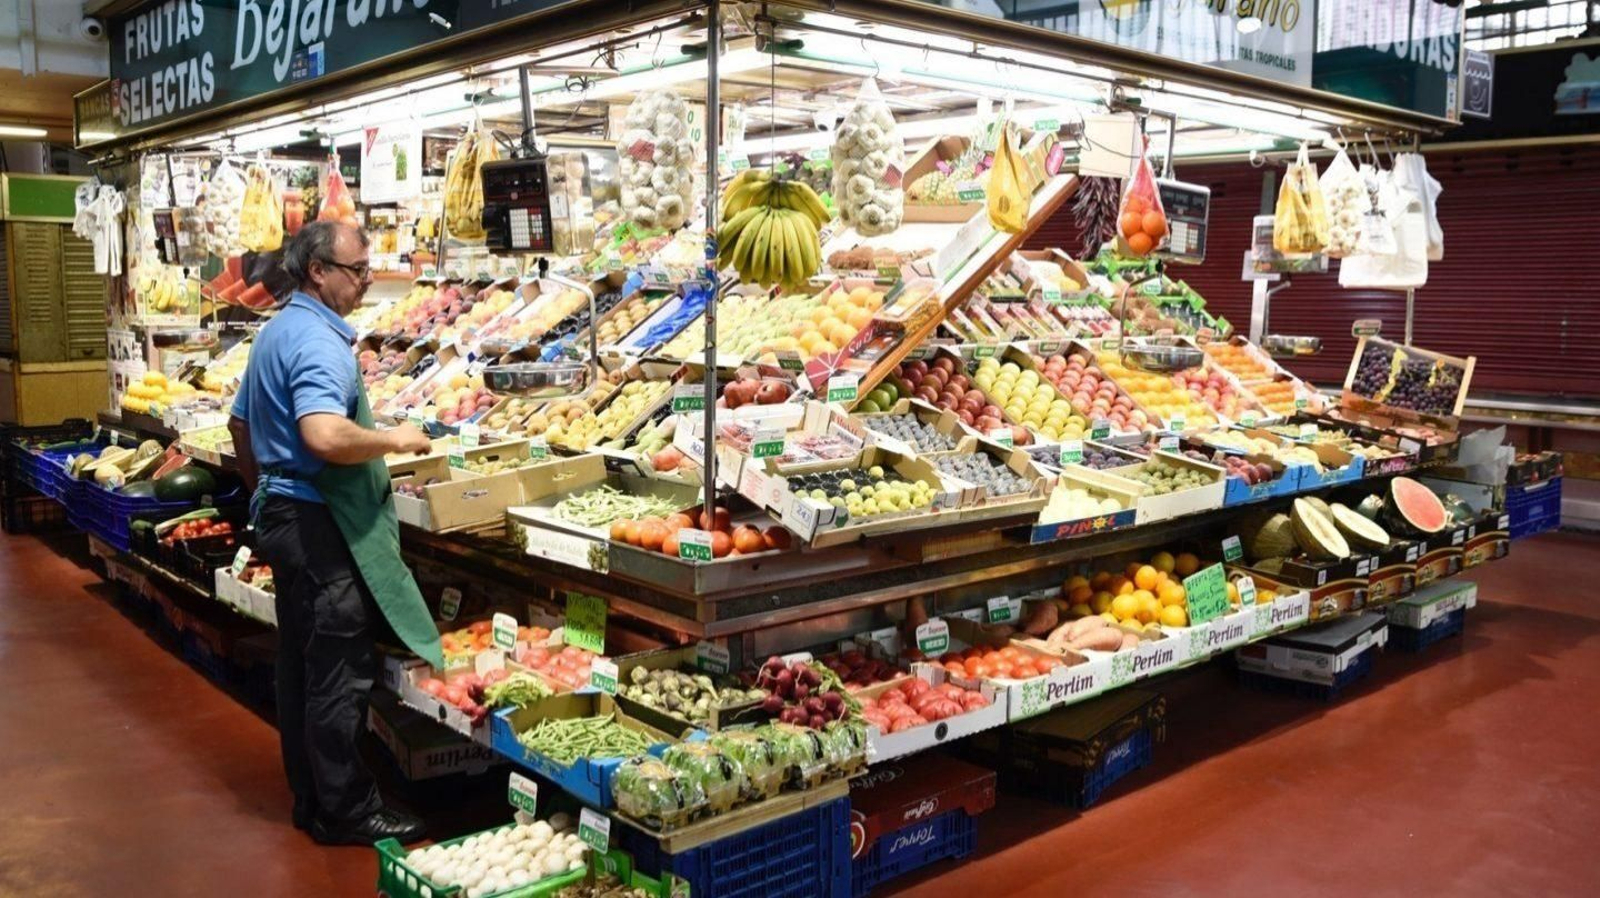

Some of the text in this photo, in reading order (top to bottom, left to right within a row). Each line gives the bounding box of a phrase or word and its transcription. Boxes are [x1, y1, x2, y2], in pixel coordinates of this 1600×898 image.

[124, 0, 204, 64] FRUTAS
[1255, 50, 1296, 71] TROPICALES
[120, 51, 215, 127] SELECTAS
[1271, 603, 1303, 624] Perlim
[1208, 625, 1243, 646] Perlim
[1132, 647, 1174, 673] Perlim
[1047, 674, 1094, 702] Perlim
[889, 825, 936, 854] Torres
